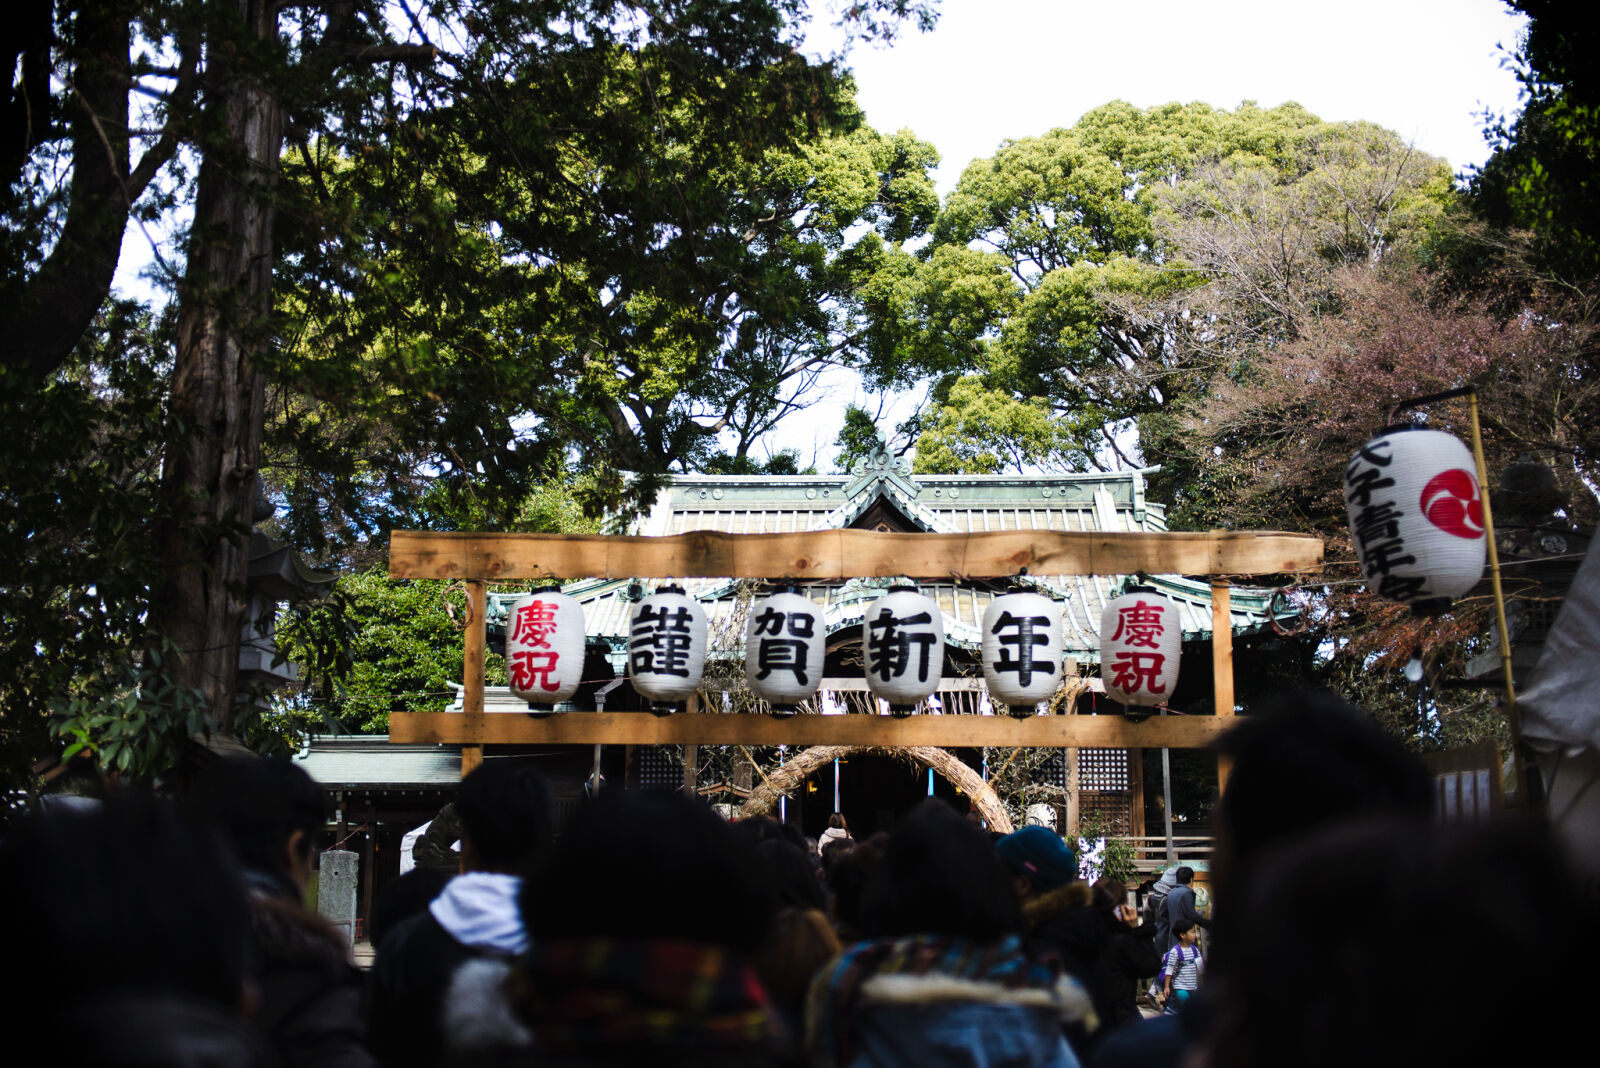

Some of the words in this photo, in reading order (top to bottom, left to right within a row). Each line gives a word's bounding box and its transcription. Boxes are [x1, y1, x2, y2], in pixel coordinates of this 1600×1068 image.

[510, 599, 561, 692] 慶祝
[630, 604, 694, 678] 謹
[753, 607, 816, 686] 賀
[868, 608, 938, 682] 新
[991, 611, 1056, 688] 年
[1110, 600, 1166, 695] 慶祝
